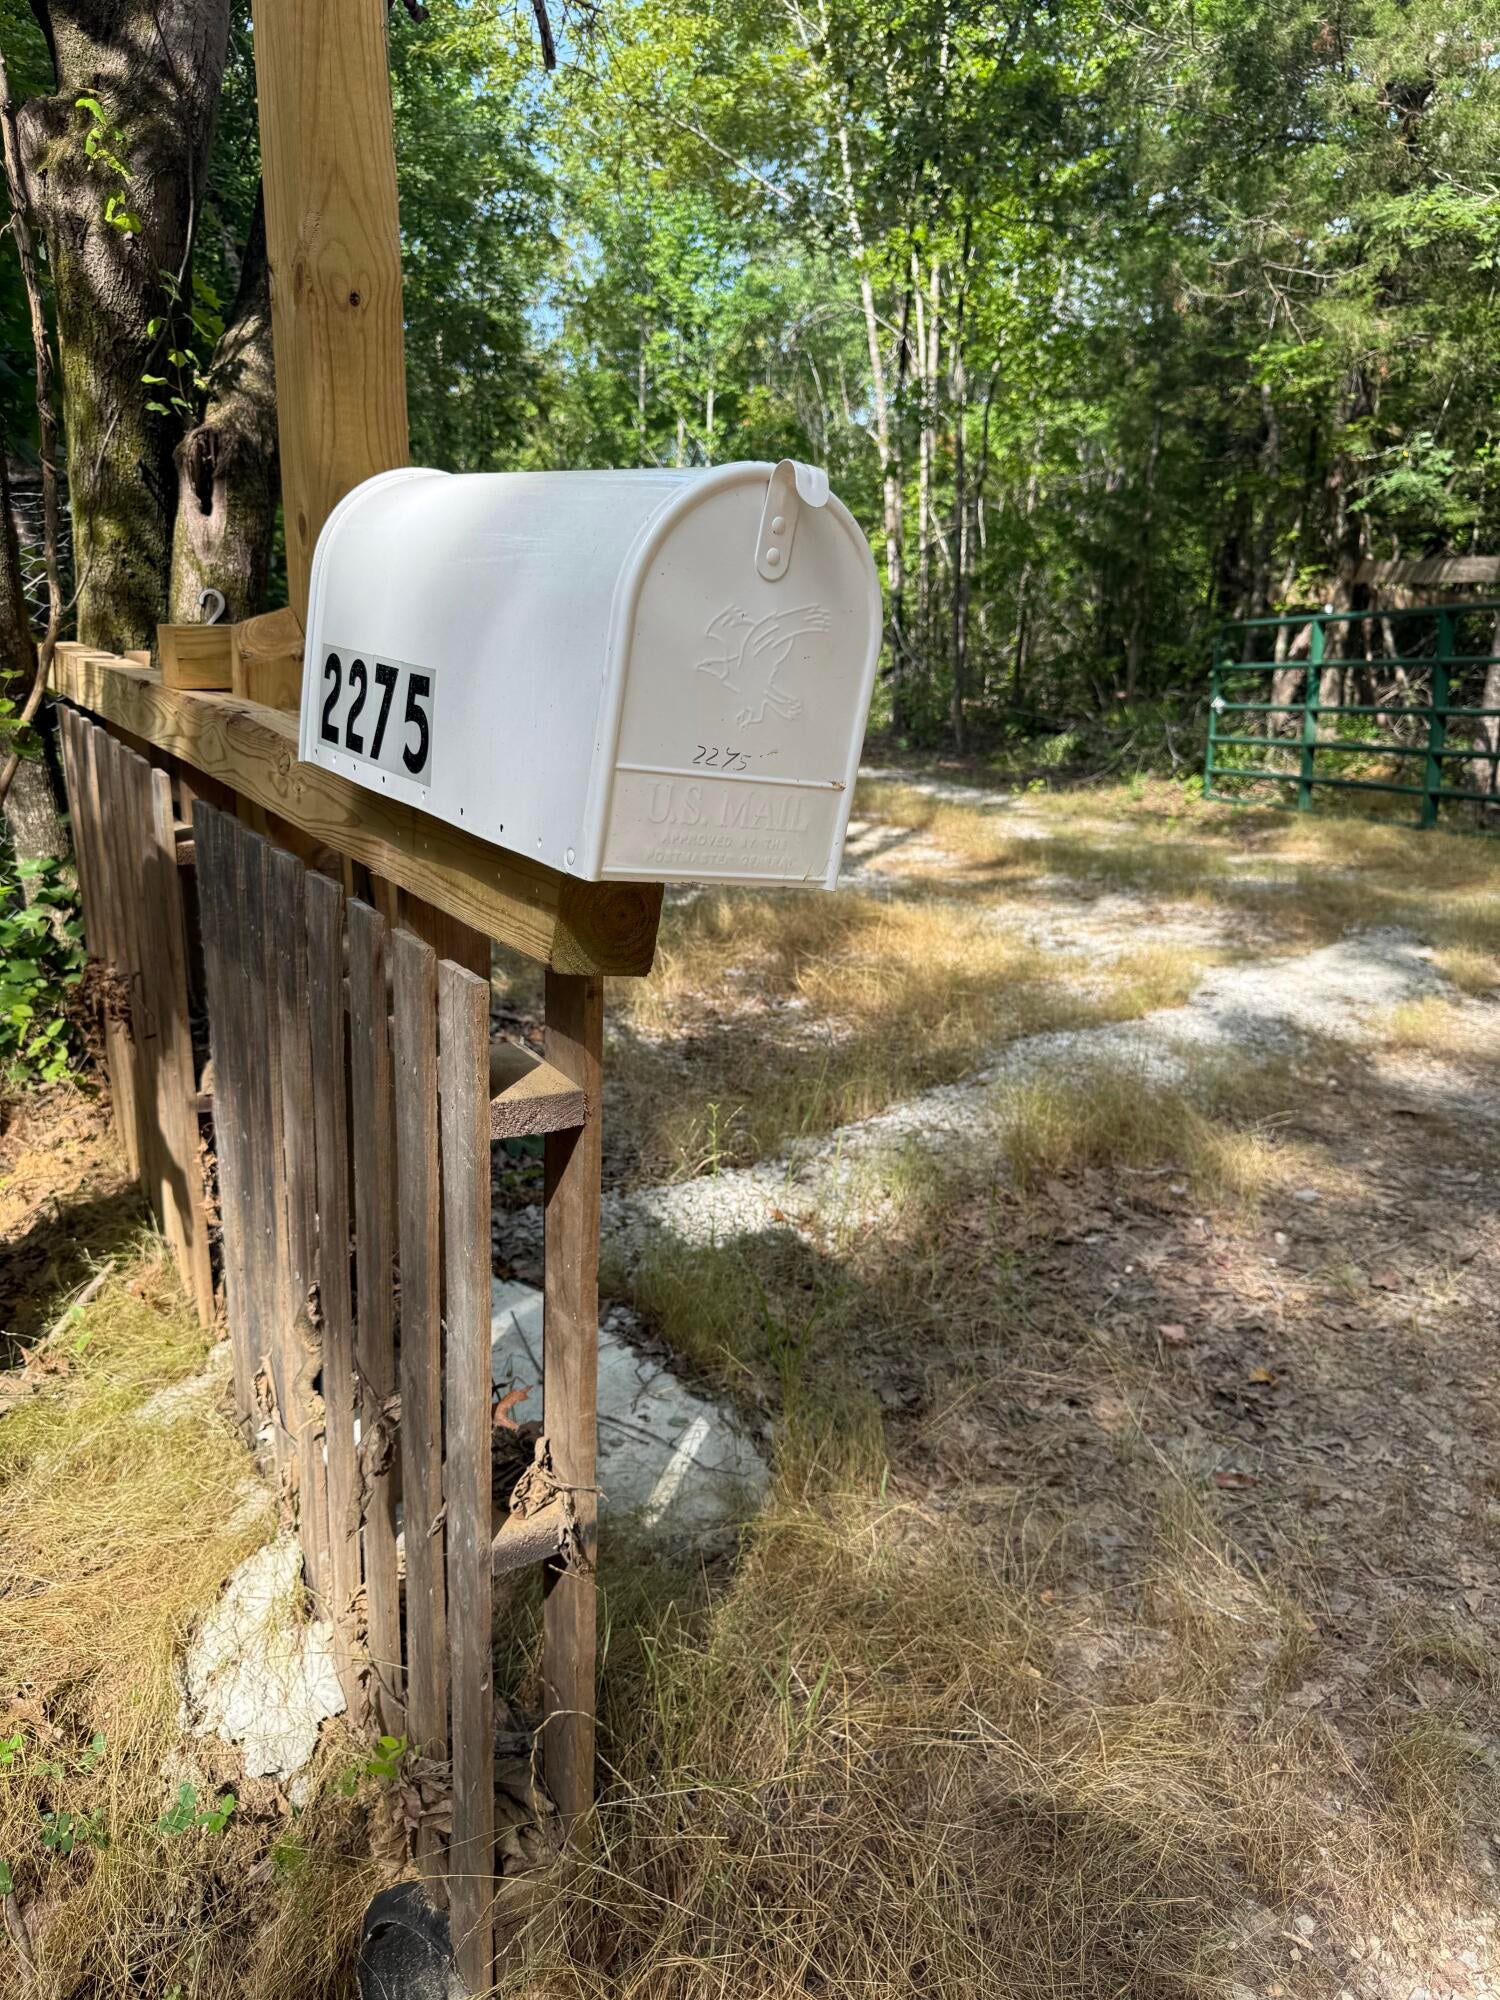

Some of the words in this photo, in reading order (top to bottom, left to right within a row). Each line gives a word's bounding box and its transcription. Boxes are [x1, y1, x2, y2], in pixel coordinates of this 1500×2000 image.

[321, 653, 431, 774] 2275
[692, 745, 751, 771] 2275
[648, 782, 708, 827] U.S.
[716, 789, 809, 832] MAIL
[661, 830, 733, 849] APPROVED
